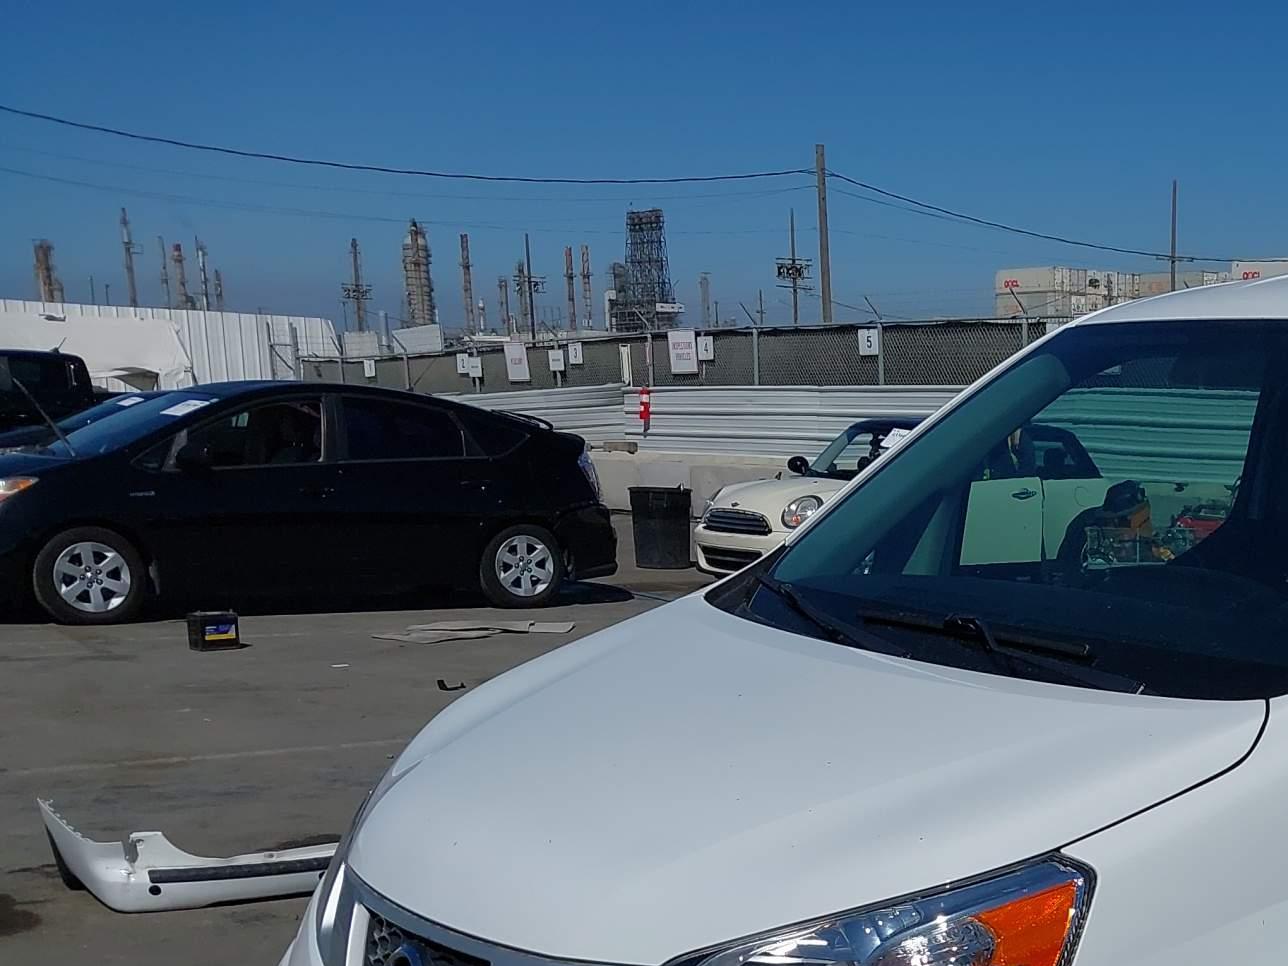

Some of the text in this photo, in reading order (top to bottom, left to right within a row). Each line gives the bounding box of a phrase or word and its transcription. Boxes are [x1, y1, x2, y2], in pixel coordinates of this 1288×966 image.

[703, 341, 709, 353] 4
[866, 335, 873, 349] 5
[573, 347, 578, 359] 3
